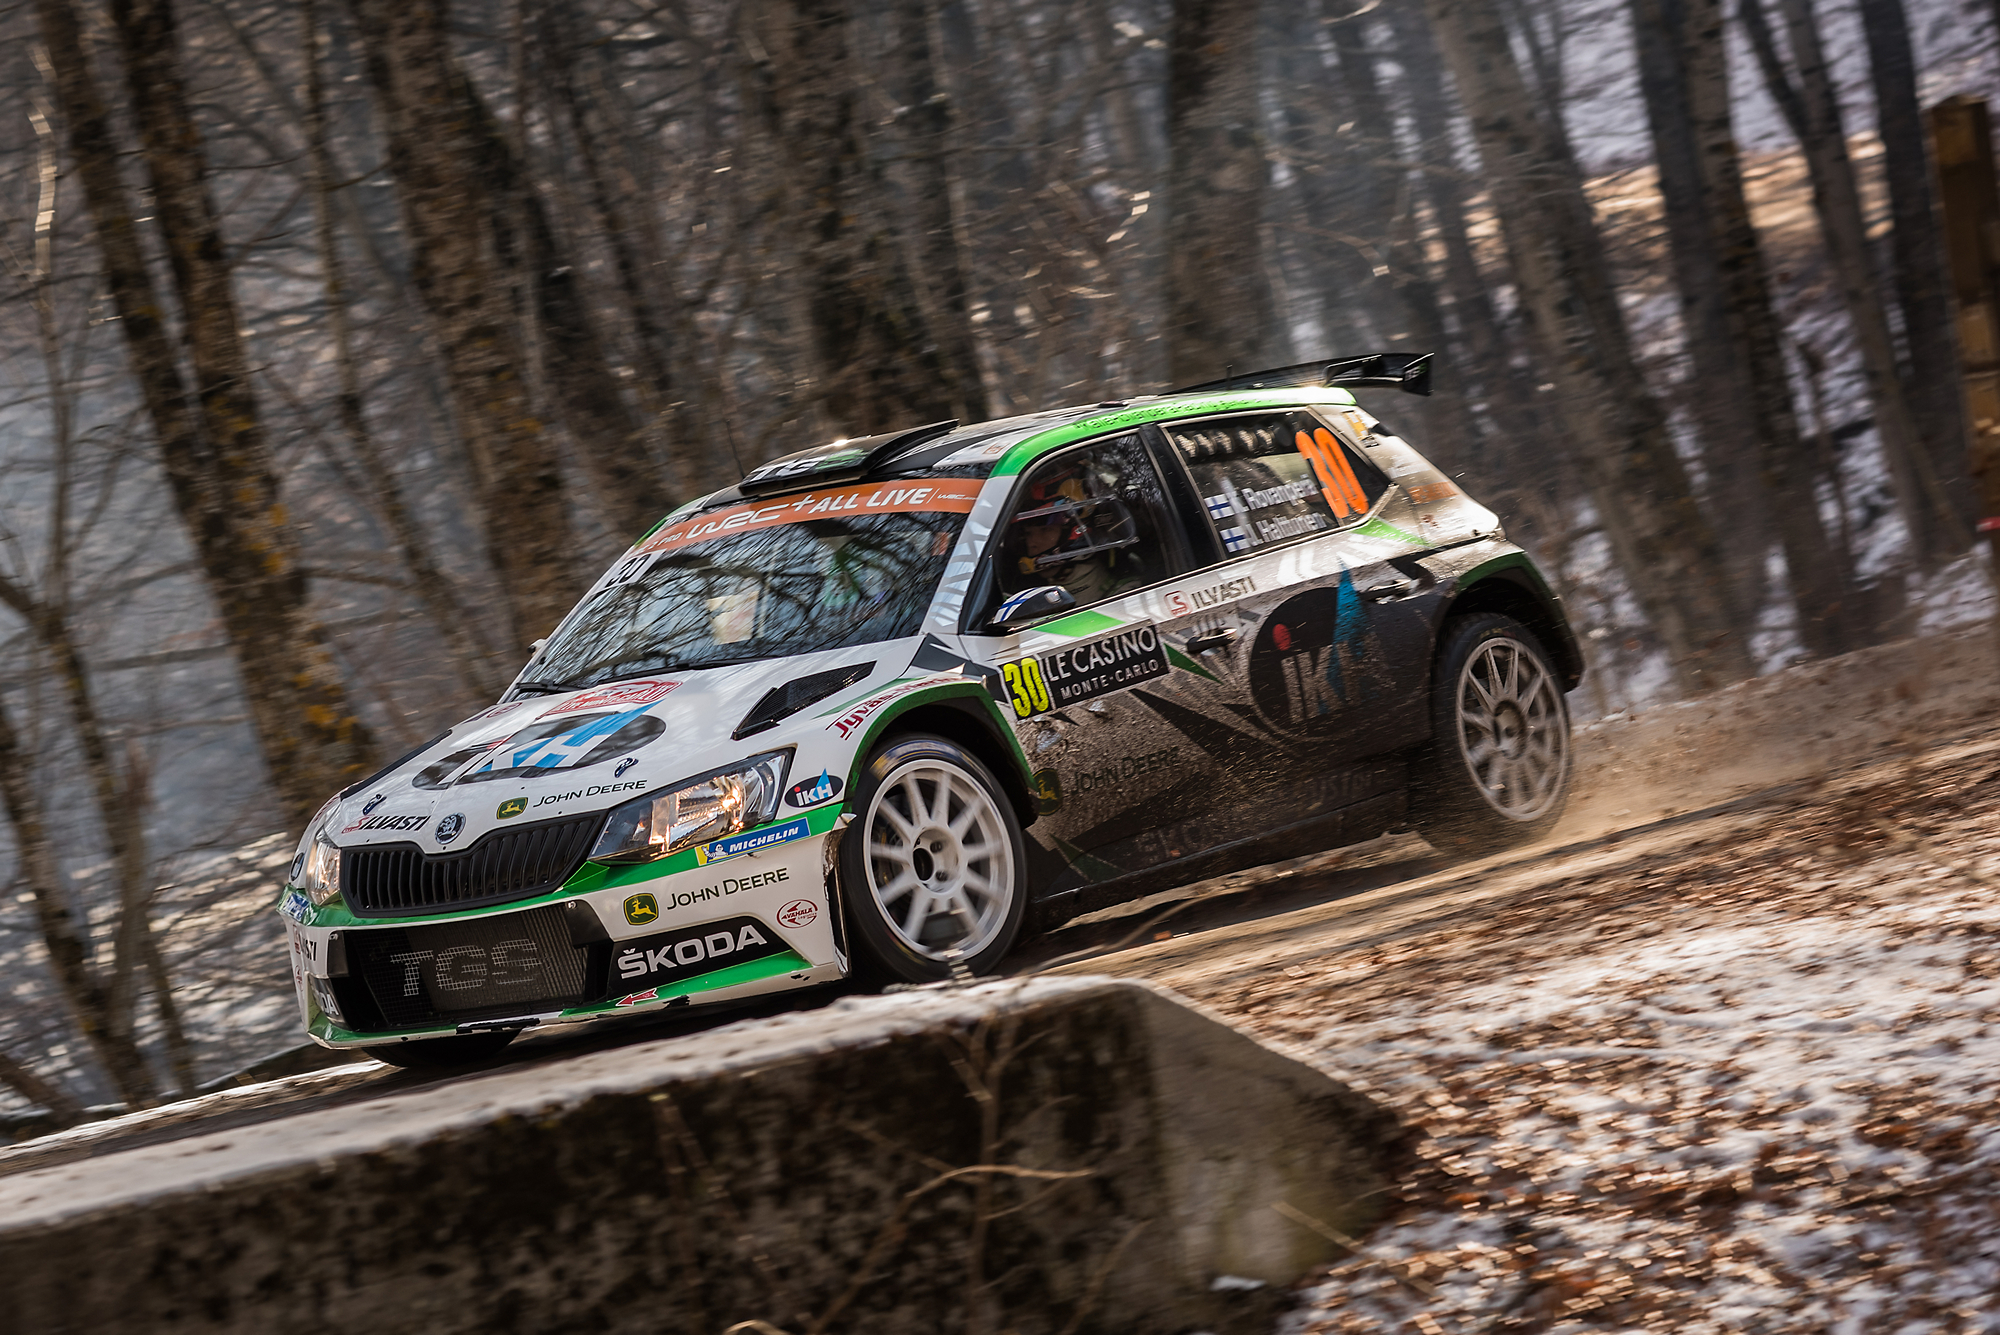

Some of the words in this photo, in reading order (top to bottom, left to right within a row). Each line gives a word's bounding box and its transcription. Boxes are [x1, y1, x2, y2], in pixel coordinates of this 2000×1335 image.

[1295, 427, 1369, 519] 30
[808, 493, 859, 514] ALL
[866, 487, 934, 507] LIVE
[604, 554, 651, 589] 30
[1003, 657, 1050, 718] 30
[1044, 656, 1072, 682] LE
[1072, 626, 1158, 673] CASINO
[532, 790, 583, 808] JOHN
[585, 779, 648, 797] DEERE
[729, 826, 799, 853] MICHELIN
[666, 884, 720, 911] JOHN
[722, 867, 790, 896] DEERE
[616, 923, 768, 980] ŠKODA
